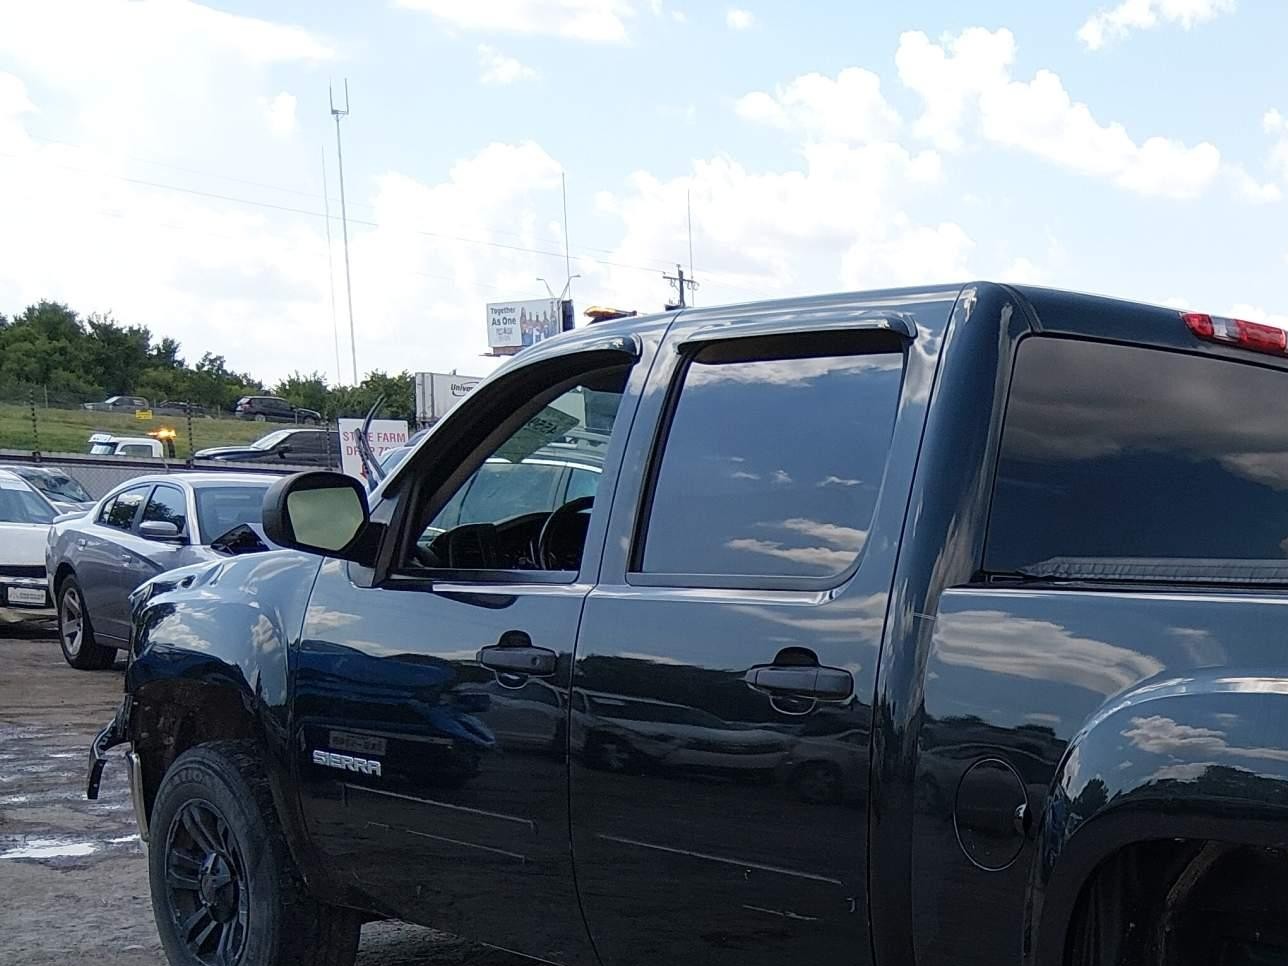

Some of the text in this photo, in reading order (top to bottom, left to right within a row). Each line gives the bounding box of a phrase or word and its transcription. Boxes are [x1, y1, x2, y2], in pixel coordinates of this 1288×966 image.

[490, 307, 516, 316] Together
[492, 317, 517, 326] As One
[343, 431, 406, 443] STE FARM
[313, 749, 382, 777] SIERRA
